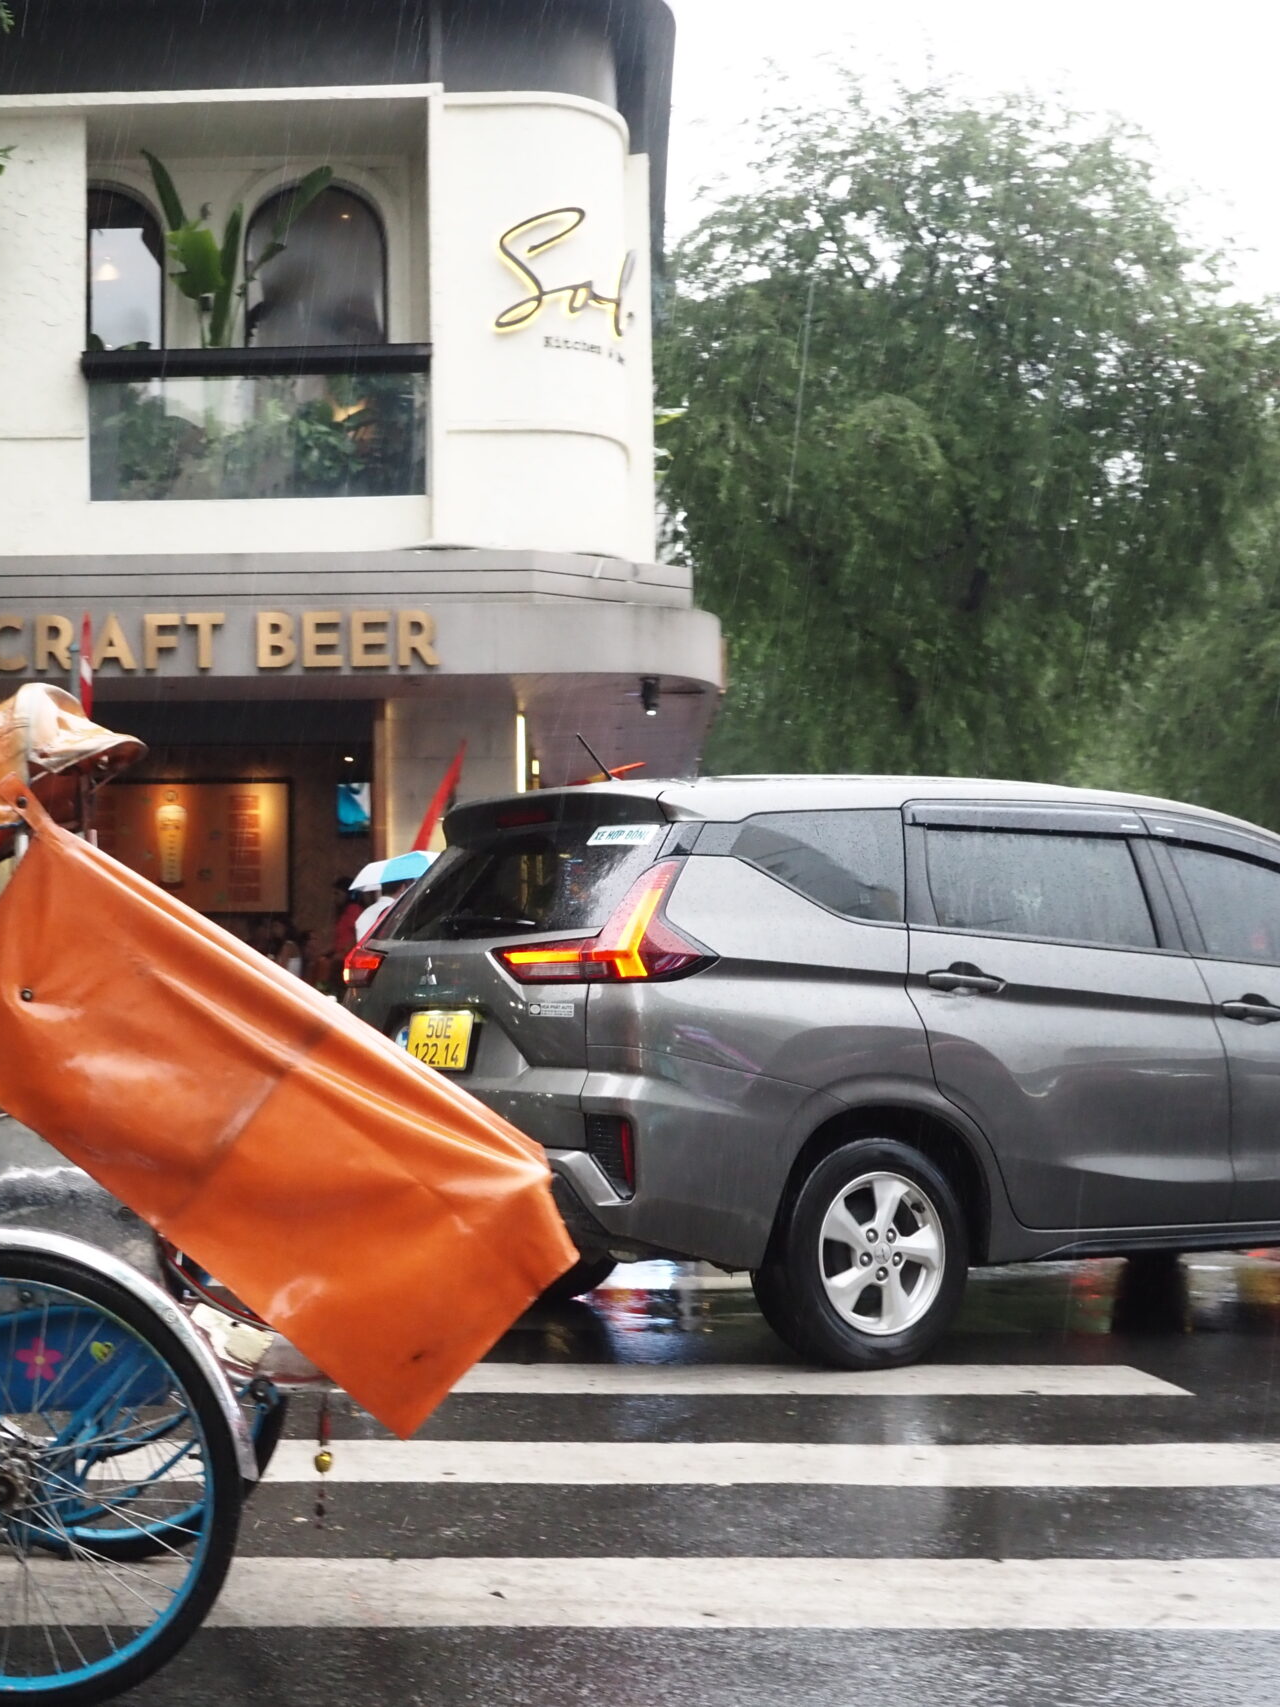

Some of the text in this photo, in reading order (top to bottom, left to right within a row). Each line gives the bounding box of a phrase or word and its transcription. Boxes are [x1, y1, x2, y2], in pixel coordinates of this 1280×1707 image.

[256, 609, 442, 669] BEER
[426, 1016, 454, 1039] 50E
[414, 1042, 461, 1065] 122.14
